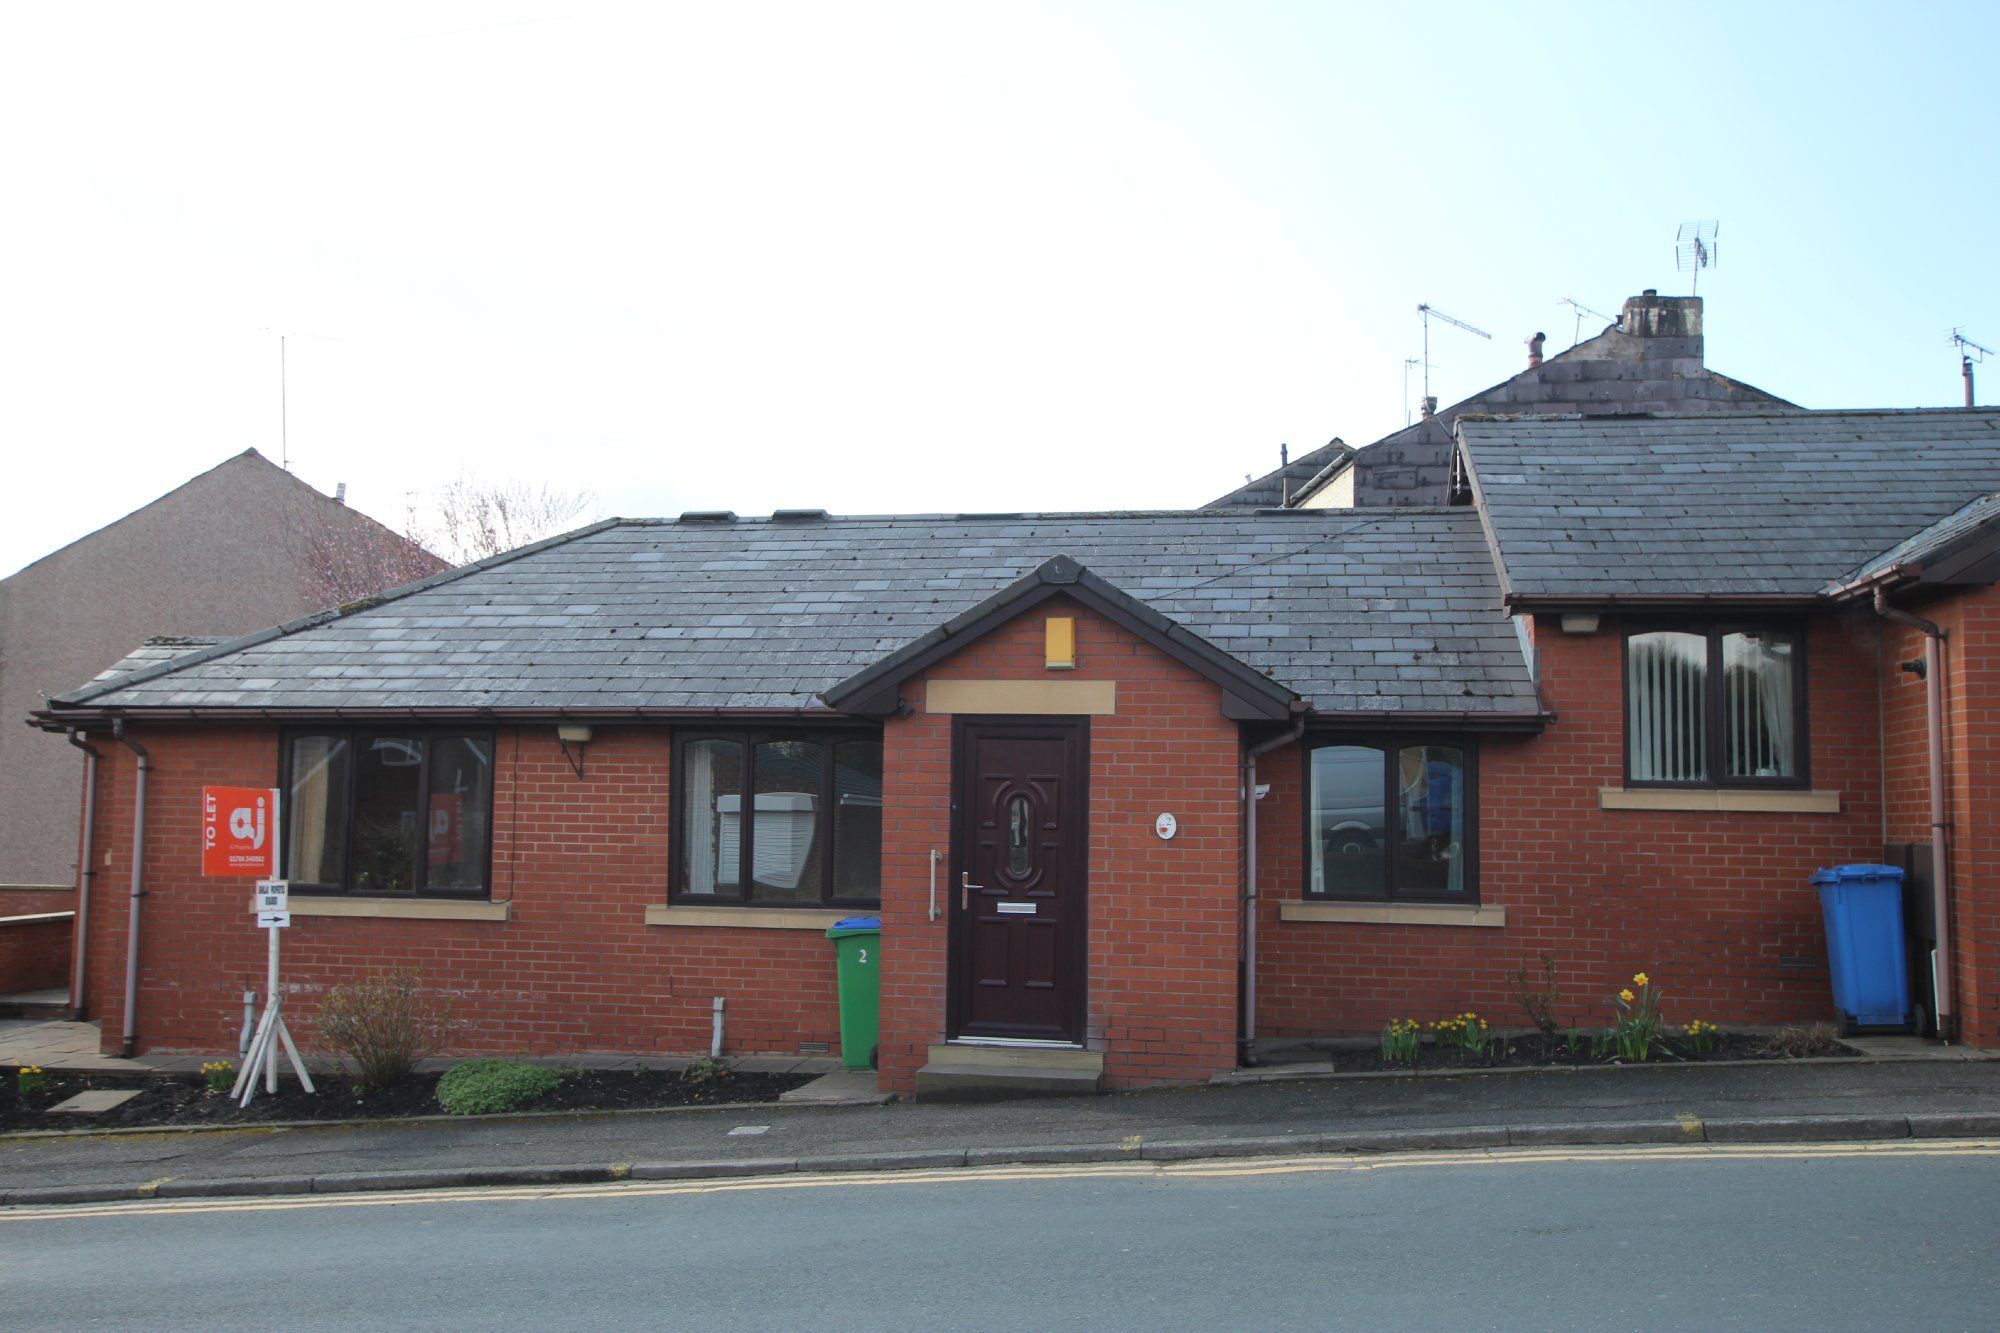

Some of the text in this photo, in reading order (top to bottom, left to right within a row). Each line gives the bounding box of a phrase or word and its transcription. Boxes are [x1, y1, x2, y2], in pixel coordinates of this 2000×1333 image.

[206, 793, 217, 850] TO LET
[1165, 817, 1172, 826] 2
[858, 948, 868, 964] 2
